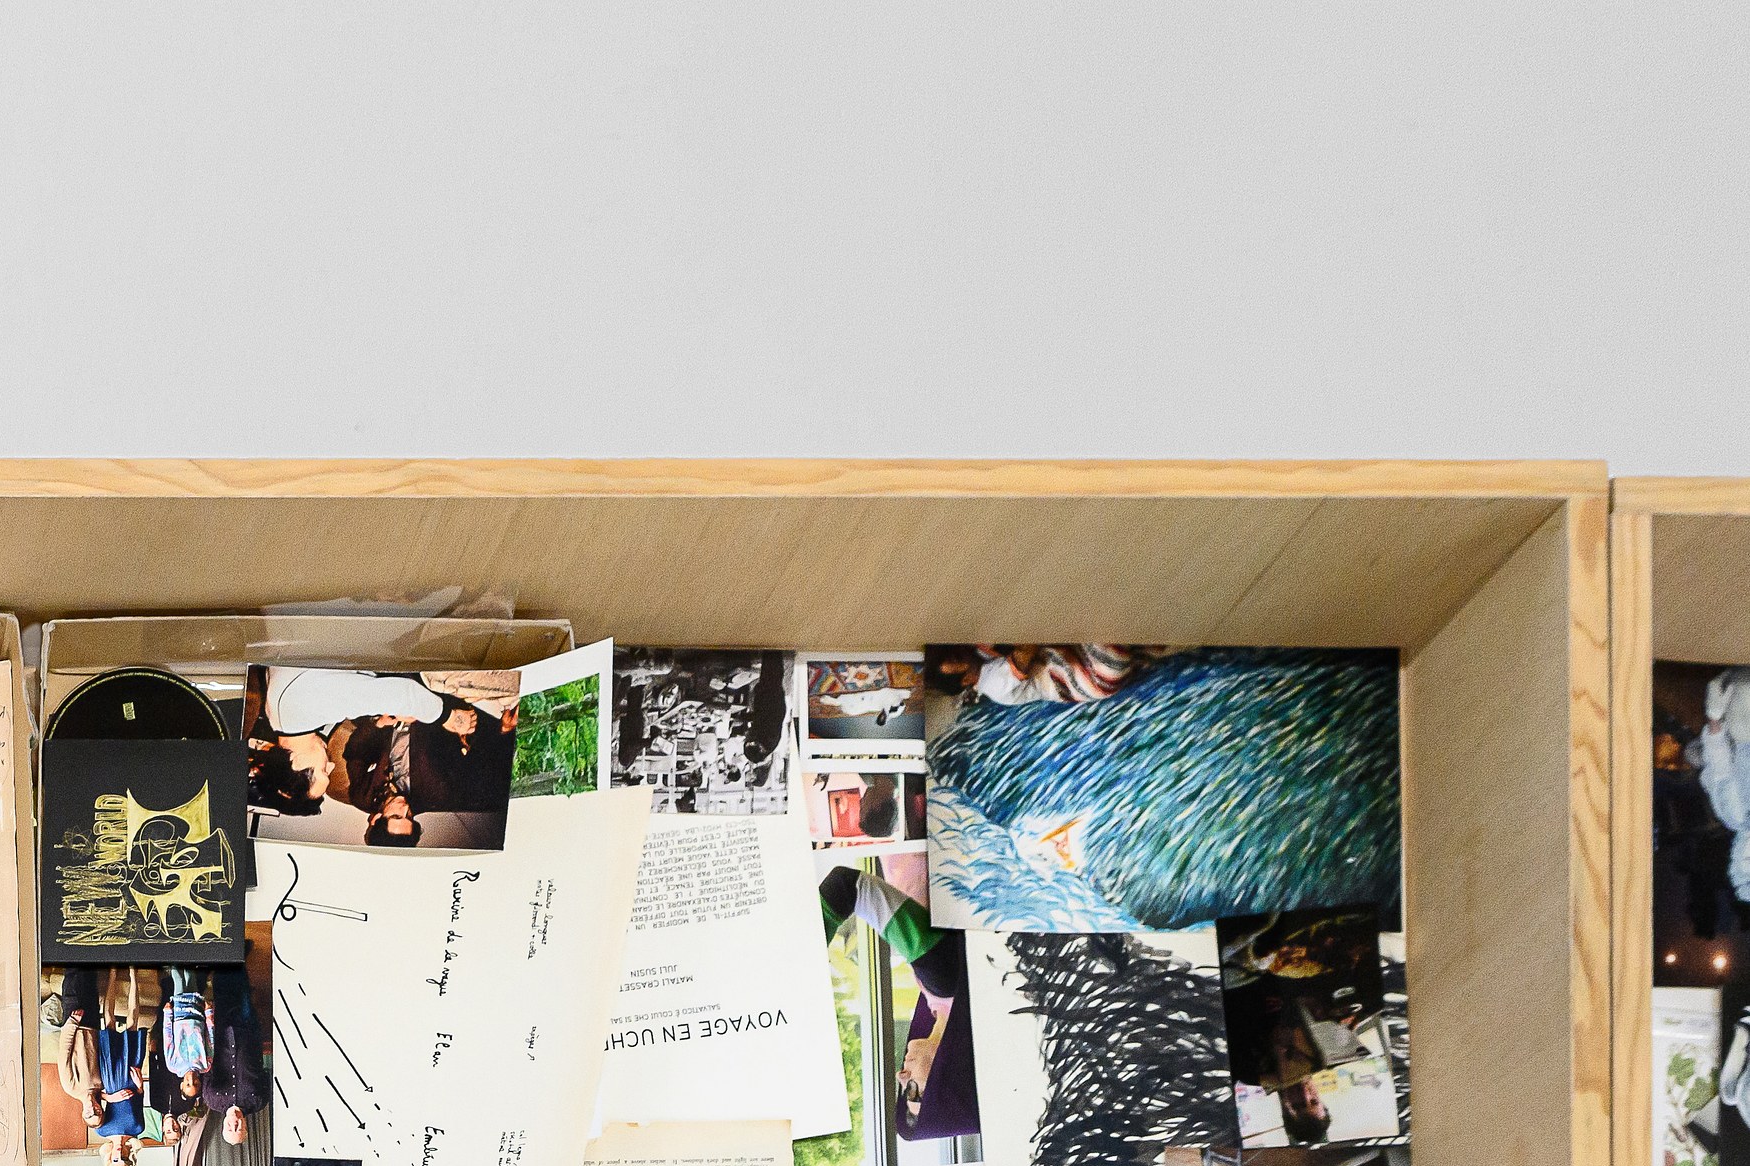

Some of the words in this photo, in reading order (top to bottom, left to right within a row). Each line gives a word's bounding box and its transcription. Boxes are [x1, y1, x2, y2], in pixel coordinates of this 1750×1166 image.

[630, 967, 657, 978] SUSIN
[659, 964, 678, 975] JULI
[619, 979, 660, 993] CRASSET
[661, 975, 694, 987] MATALI
[698, 1009, 788, 1038] VOYAGE
[662, 1023, 691, 1043] EN
